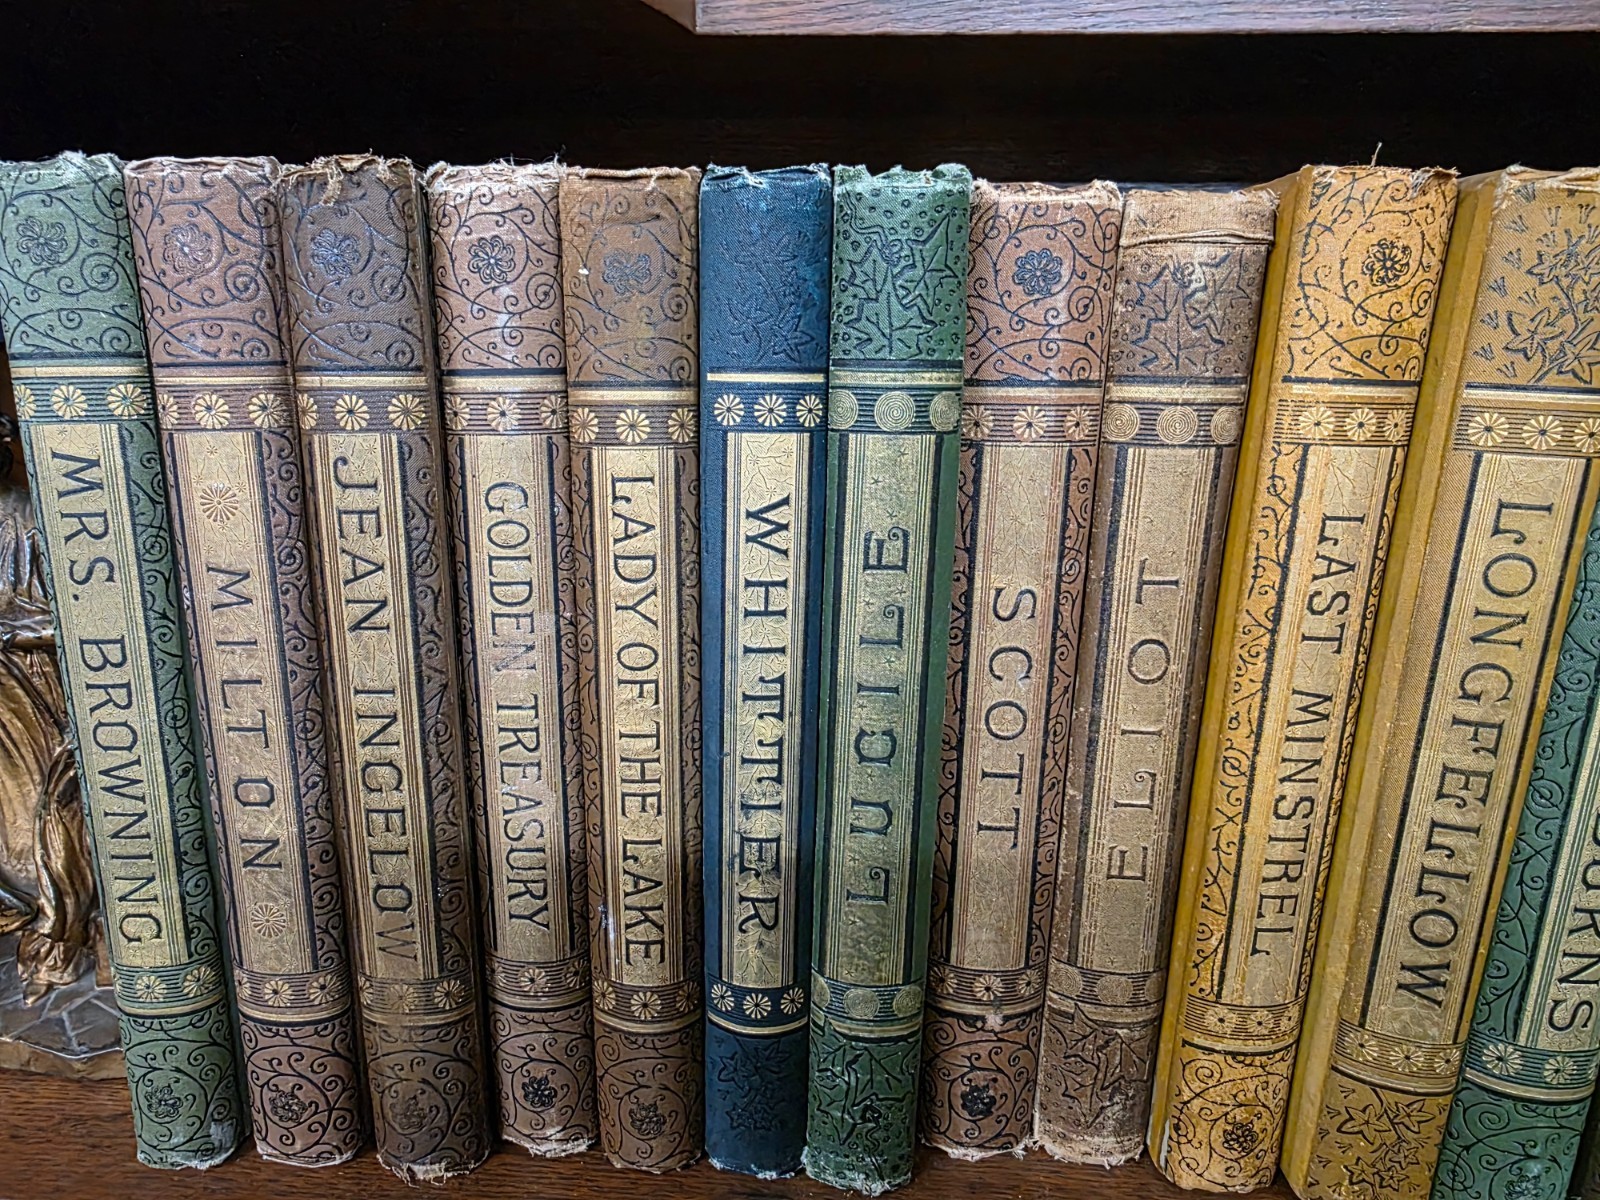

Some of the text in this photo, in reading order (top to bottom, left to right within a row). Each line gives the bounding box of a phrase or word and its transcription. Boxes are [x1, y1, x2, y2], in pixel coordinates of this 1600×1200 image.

[50, 448, 162, 945] MRS. BROWNING
[206, 565, 282, 870] MILTON
[333, 456, 417, 963] JEAN INGELOW
[484, 482, 550, 931] GOLDEN TREASURY
[611, 475, 666, 966] LADY OF THE LAKE
[738, 494, 790, 933] WHITTIER
[847, 526, 910, 905] LUCILE
[977, 587, 1036, 850] SCOTT
[1107, 558, 1179, 881] ELIOT
[1250, 513, 1366, 957] LAST MINSTREL
[1396, 500, 1554, 1009] LONGFELLOW
